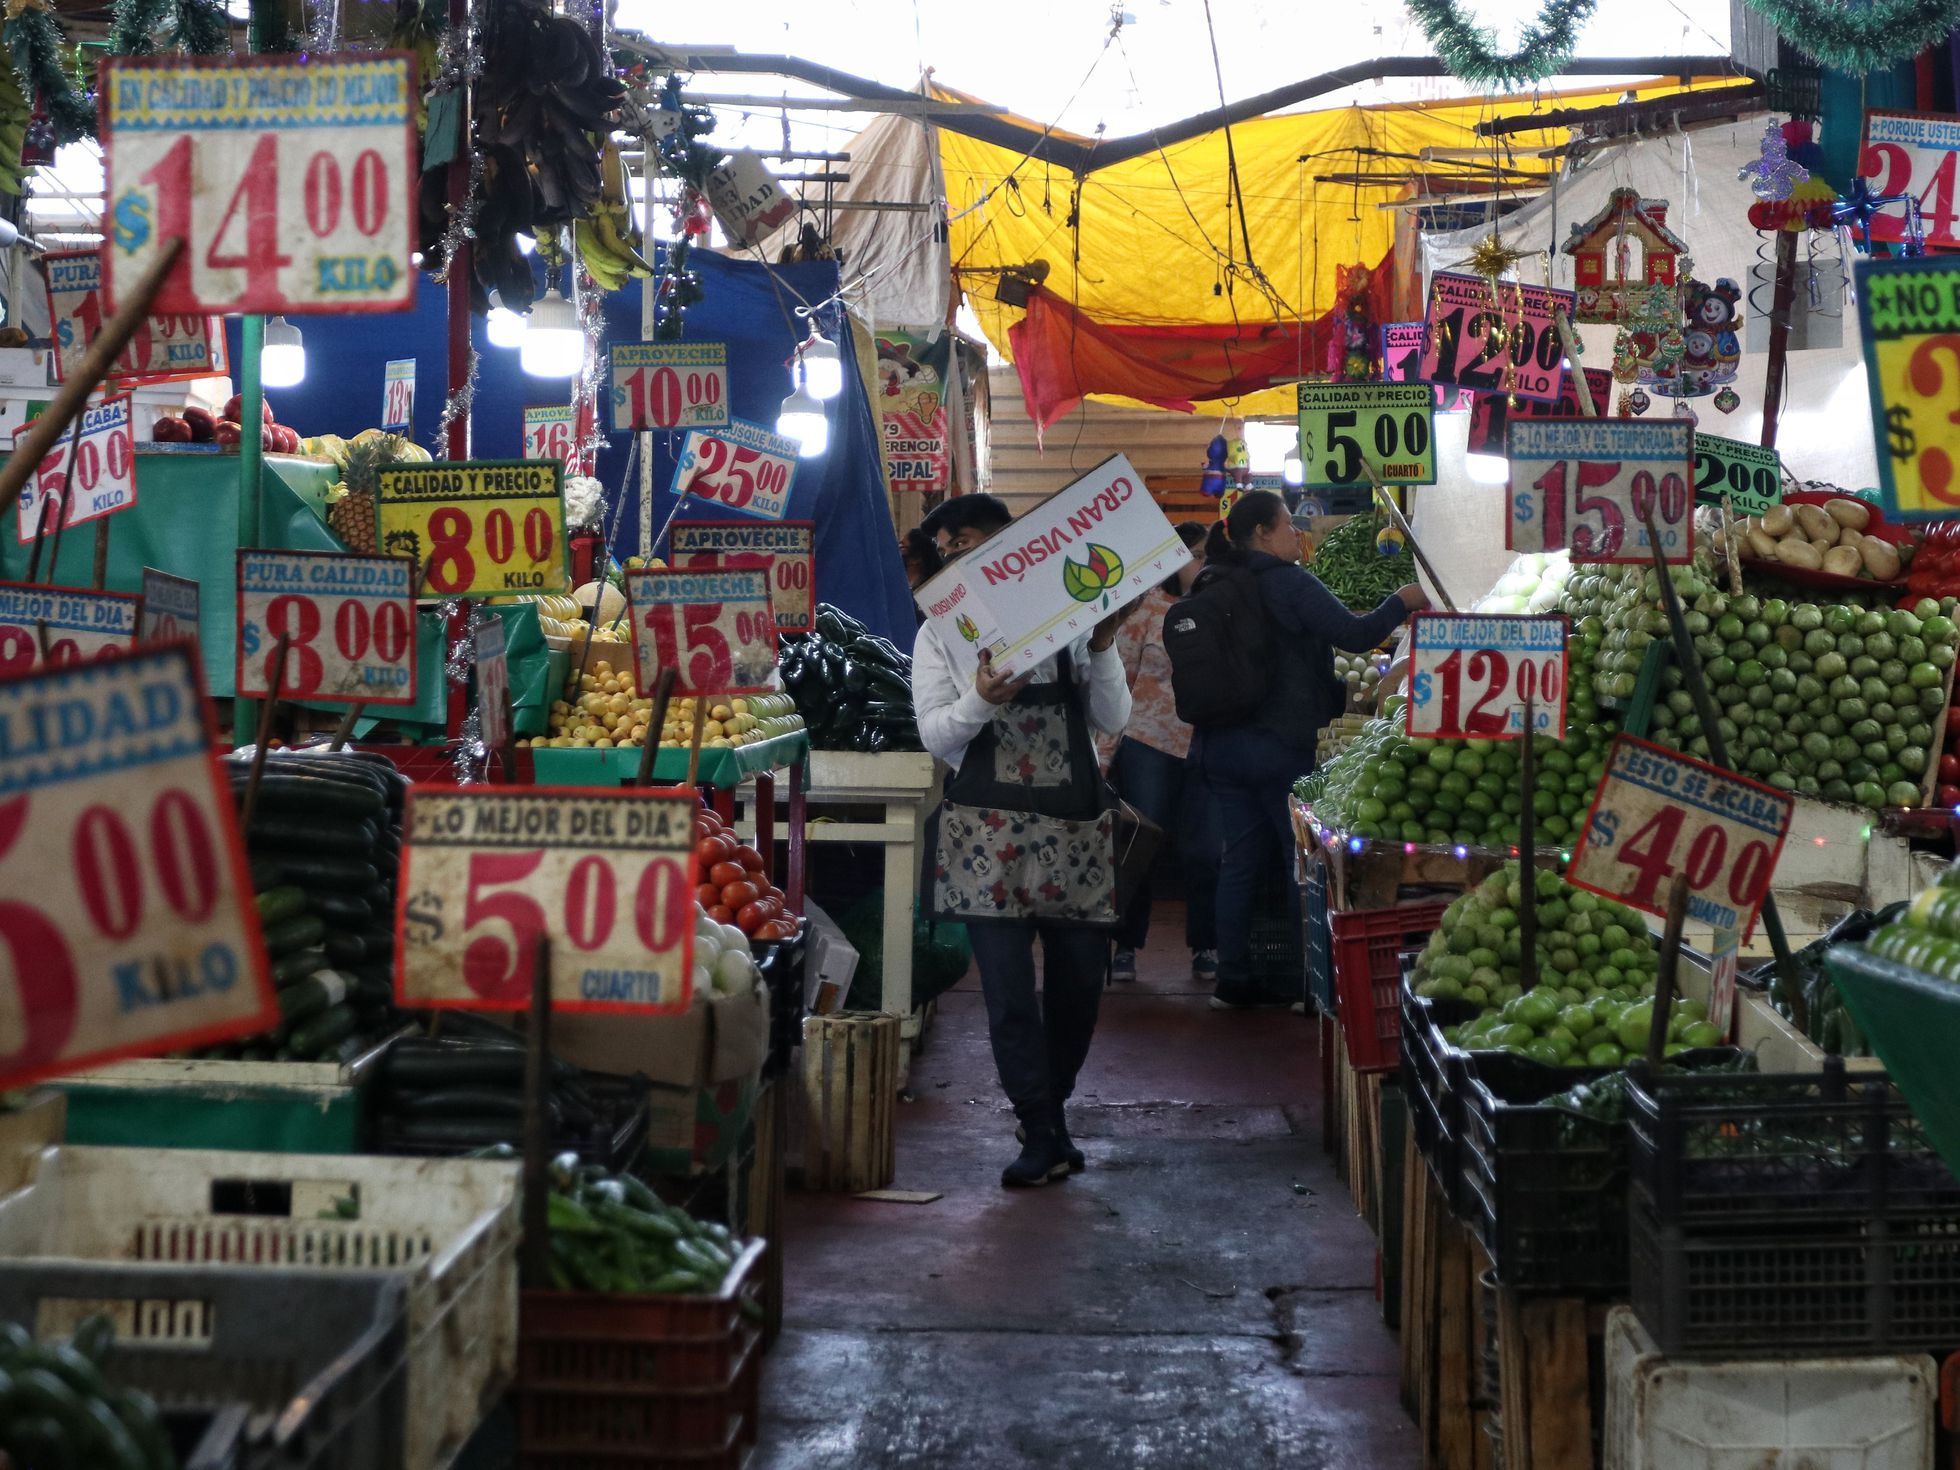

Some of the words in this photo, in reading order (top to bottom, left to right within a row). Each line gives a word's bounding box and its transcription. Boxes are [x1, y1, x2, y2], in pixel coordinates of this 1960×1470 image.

[1880, 119, 1925, 138] PORQUE
[317, 256, 399, 292] KILO
[1897, 284, 1941, 318] NO
[168, 343, 205, 361] KILO
[615, 349, 725, 361] APROVECHE
[1303, 391, 1360, 403] CALIDAD
[1366, 391, 1373, 401] Y
[1378, 390, 1427, 401] PRECIO
[80, 405, 122, 429] CABA
[695, 407, 725, 421] KILO
[768, 435, 791, 451] MAS
[886, 440, 942, 453] ERENCIA
[1610, 429, 1675, 449] TEMPORADA
[1726, 446, 1773, 462] PRECIO
[888, 461, 934, 479] CIPAL
[393, 474, 463, 495] CALIDAD
[468, 473, 477, 492] Y
[484, 471, 542, 491] PRECIO
[93, 490, 124, 511] KILO
[751, 495, 780, 513] KILO
[1067, 476, 1134, 538] GRAN
[1730, 493, 1770, 512] KILO
[684, 531, 799, 547] APROVECHE
[980, 526, 1073, 586] VISIÓN
[244, 563, 304, 582] PURA
[310, 565, 407, 587] CALIDAD
[504, 571, 544, 588] KILO
[640, 577, 755, 598] APROVECHE
[58, 600, 89, 621] DEL
[94, 604, 123, 626] DIA
[775, 613, 809, 627] KILO
[1429, 622, 1447, 640] LO
[1451, 622, 1497, 641] MEJOR
[1501, 622, 1525, 641] DEL
[1529, 623, 1553, 642] DIA
[364, 666, 409, 686] KILO
[1626, 751, 1679, 787] ESTO
[1682, 773, 1709, 798] SE
[432, 809, 465, 833] LO
[474, 806, 561, 836] MEJOR
[570, 809, 615, 837] DEL
[626, 809, 671, 837] DIA
[113, 942, 238, 1012] KILO
[580, 968, 662, 1000] CUARTO
